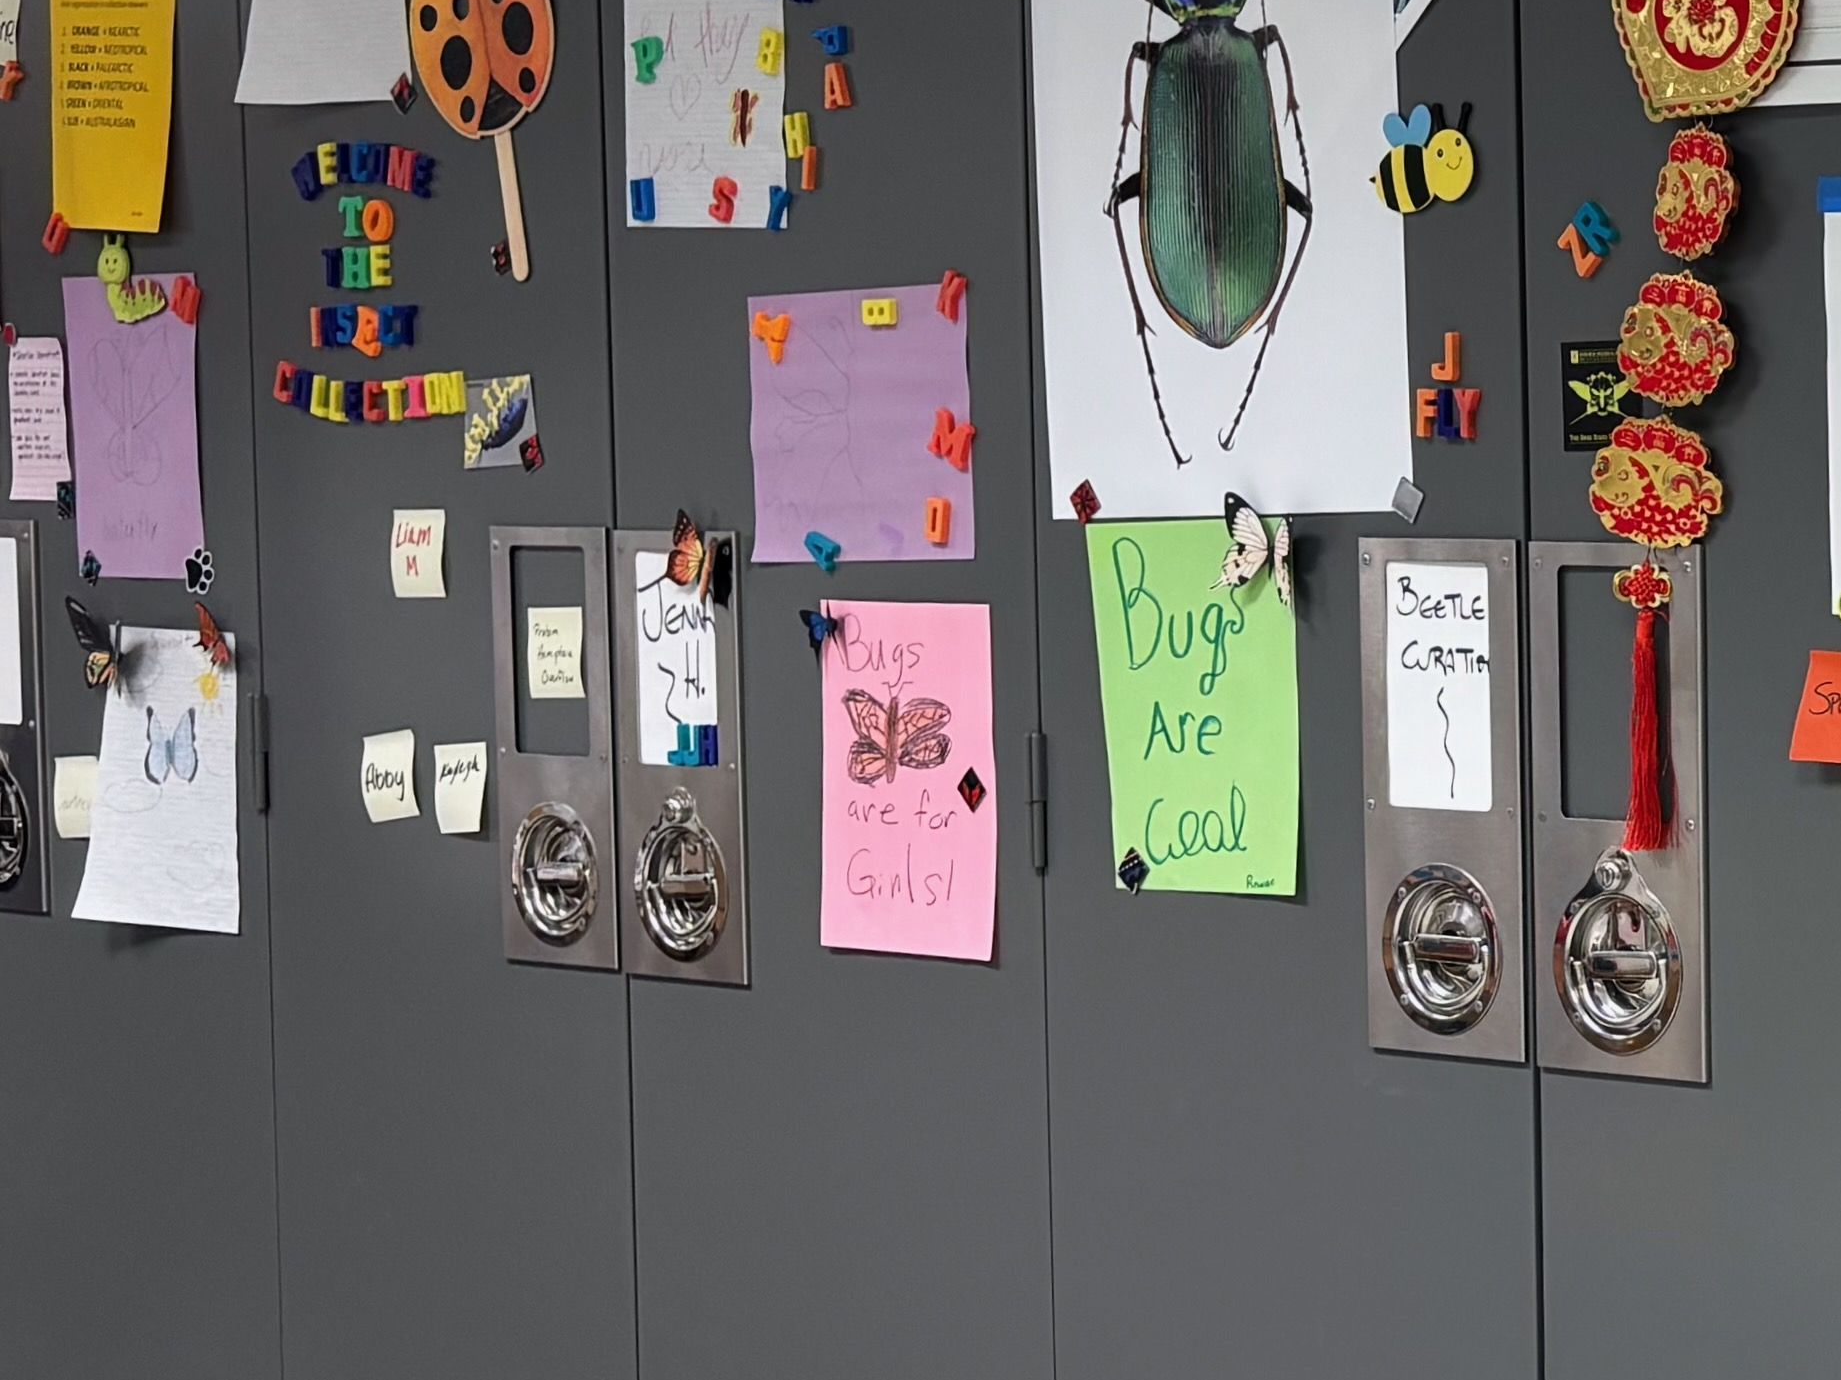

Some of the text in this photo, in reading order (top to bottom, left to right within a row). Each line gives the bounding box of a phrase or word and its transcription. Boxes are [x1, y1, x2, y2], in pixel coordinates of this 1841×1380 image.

[824, 62, 852, 110] A
[338, 195, 395, 242] TO
[708, 176, 738, 224] S
[321, 244, 393, 289] THE
[273, 360, 467, 423] COLLECTION
[1416, 387, 1482, 444] FLY
[927, 407, 975, 474] M
[396, 523, 431, 548] Liam
[406, 555, 419, 577] M
[1396, 576, 1486, 621] BEETLE
[842, 613, 925, 689] Bugs
[1143, 700, 1223, 761] Are
[365, 763, 405, 801] Abby
[848, 788, 958, 830] are for
